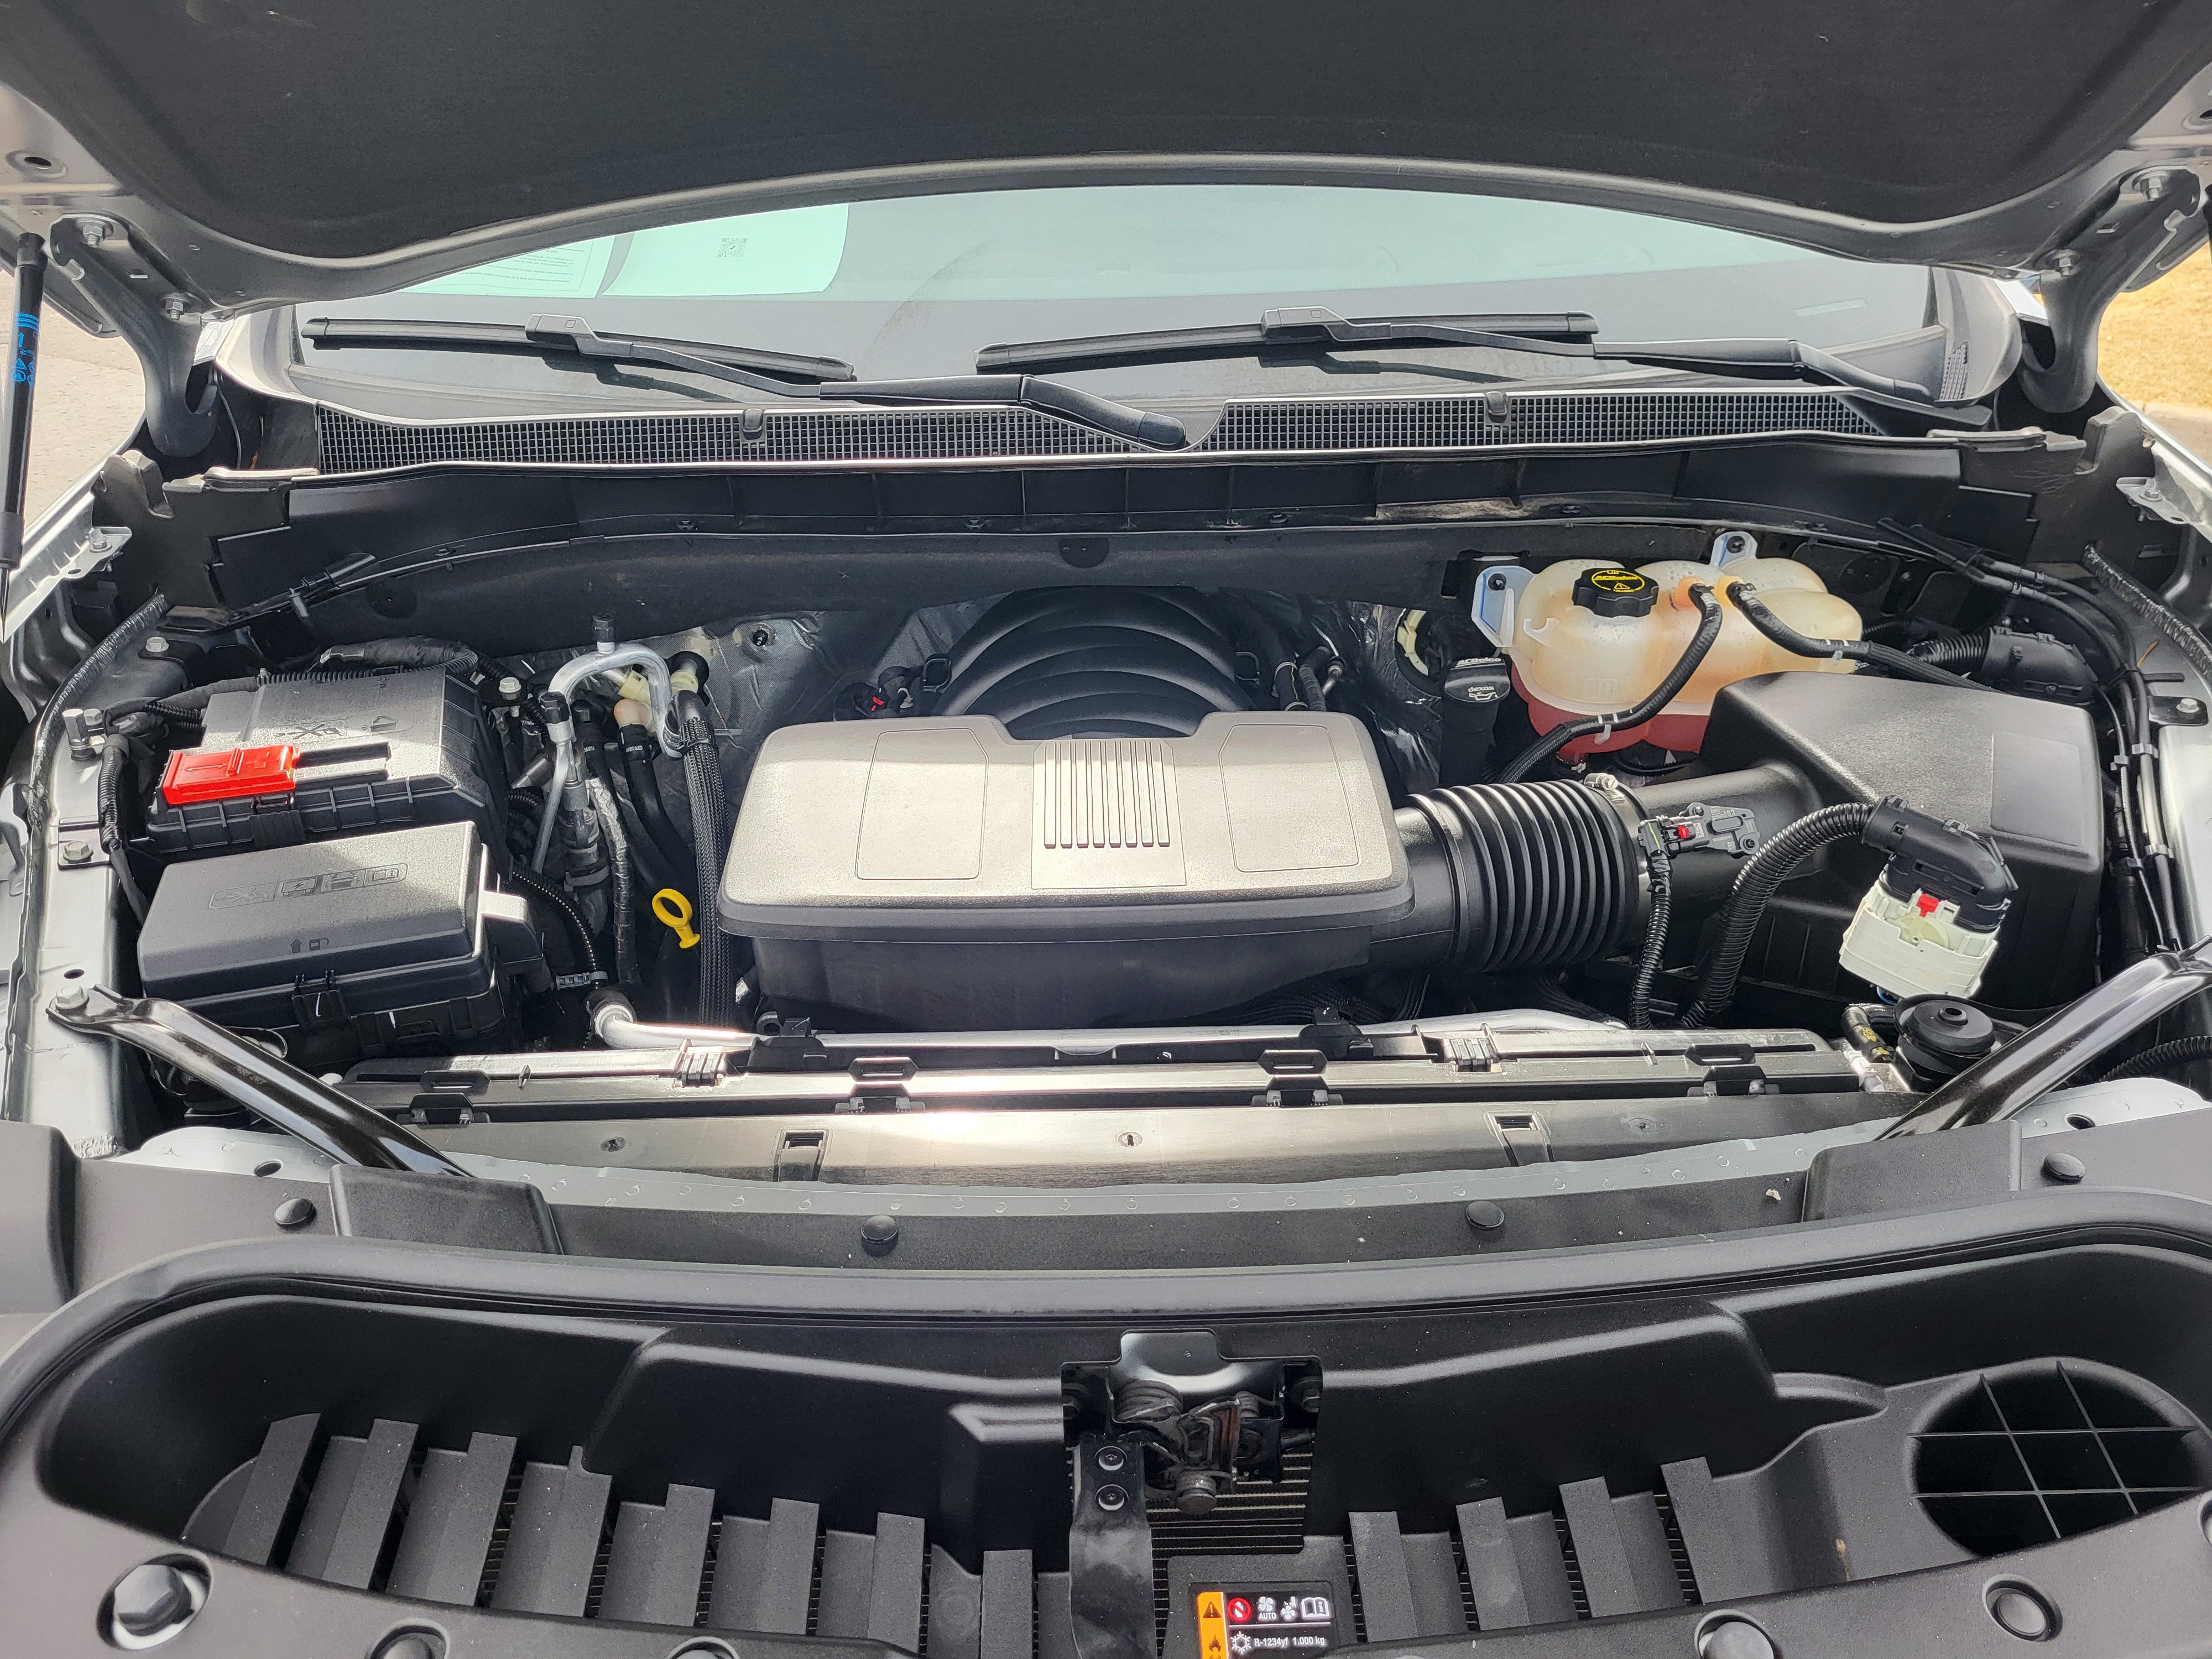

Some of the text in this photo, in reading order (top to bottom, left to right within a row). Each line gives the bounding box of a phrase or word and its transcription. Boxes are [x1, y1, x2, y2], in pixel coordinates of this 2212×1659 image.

[1456, 657, 1501, 666] ACDelco
[1254, 1636, 1325, 1648] R-1234yf 1.000 kg
